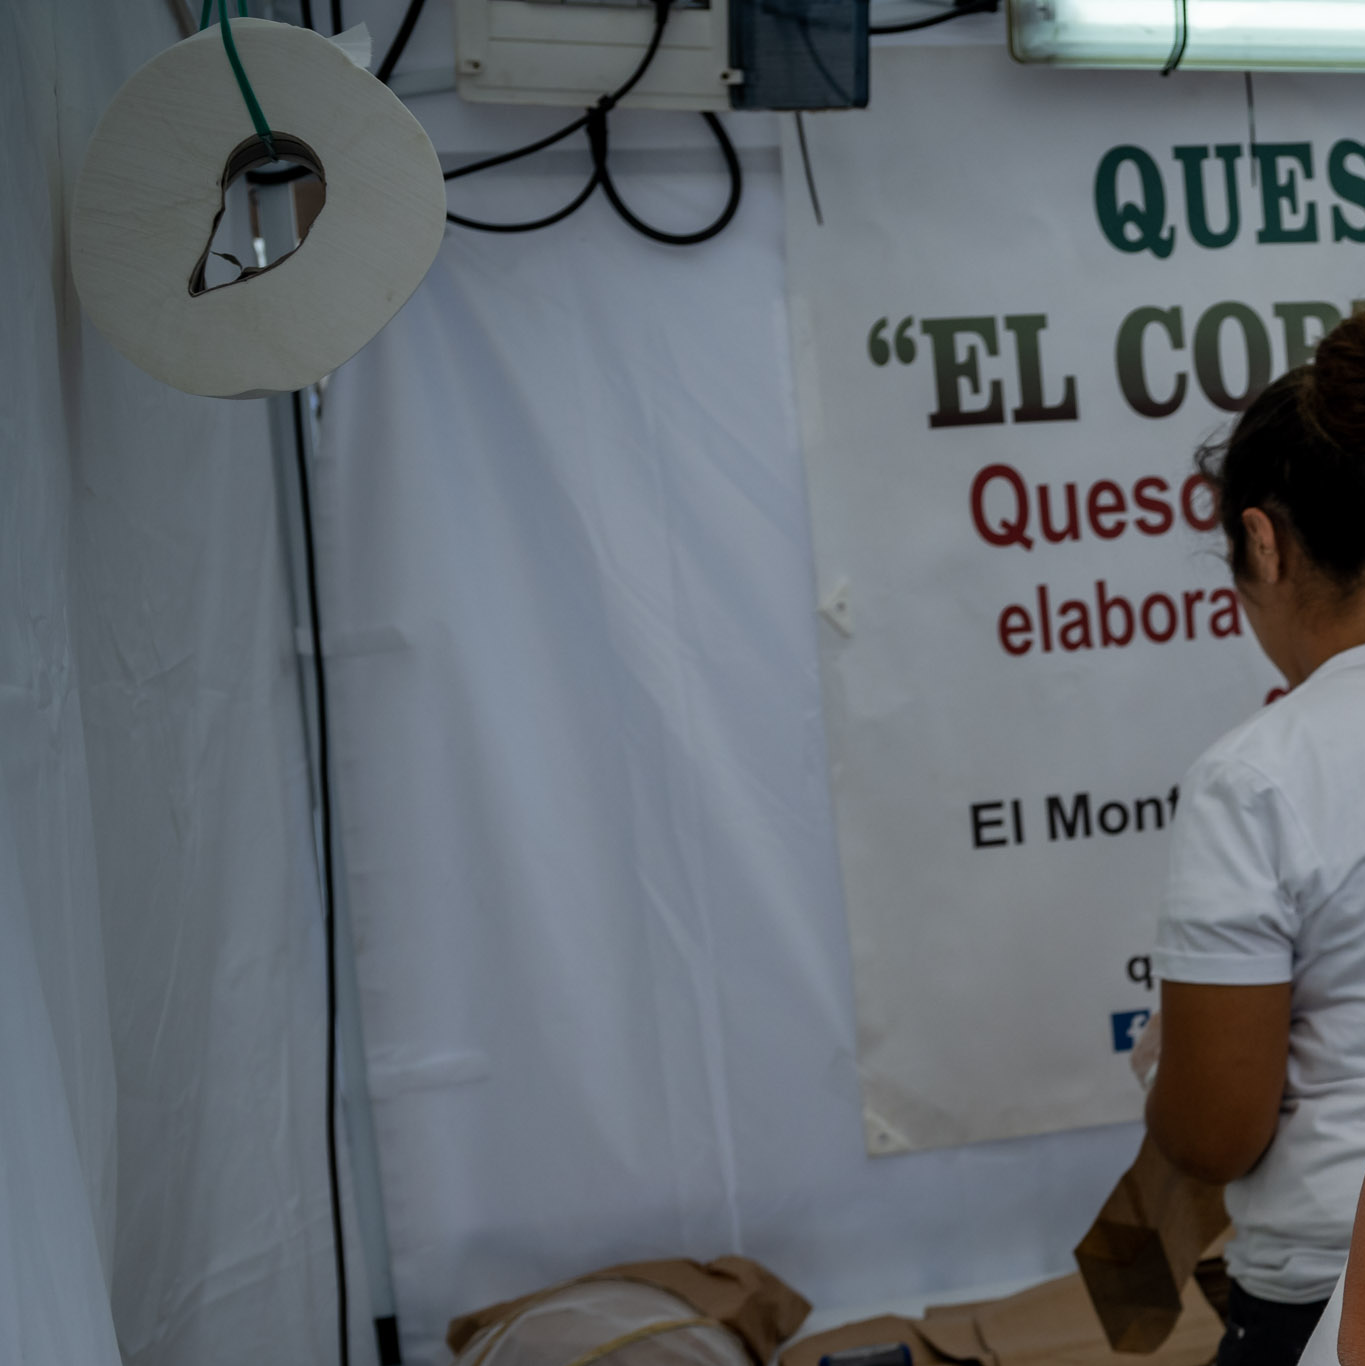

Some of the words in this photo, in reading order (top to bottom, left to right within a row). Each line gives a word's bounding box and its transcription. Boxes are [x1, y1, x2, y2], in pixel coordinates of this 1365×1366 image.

[970, 463, 1224, 551] Queso
[999, 580, 1244, 656] elabora
[970, 798, 1024, 850] El
